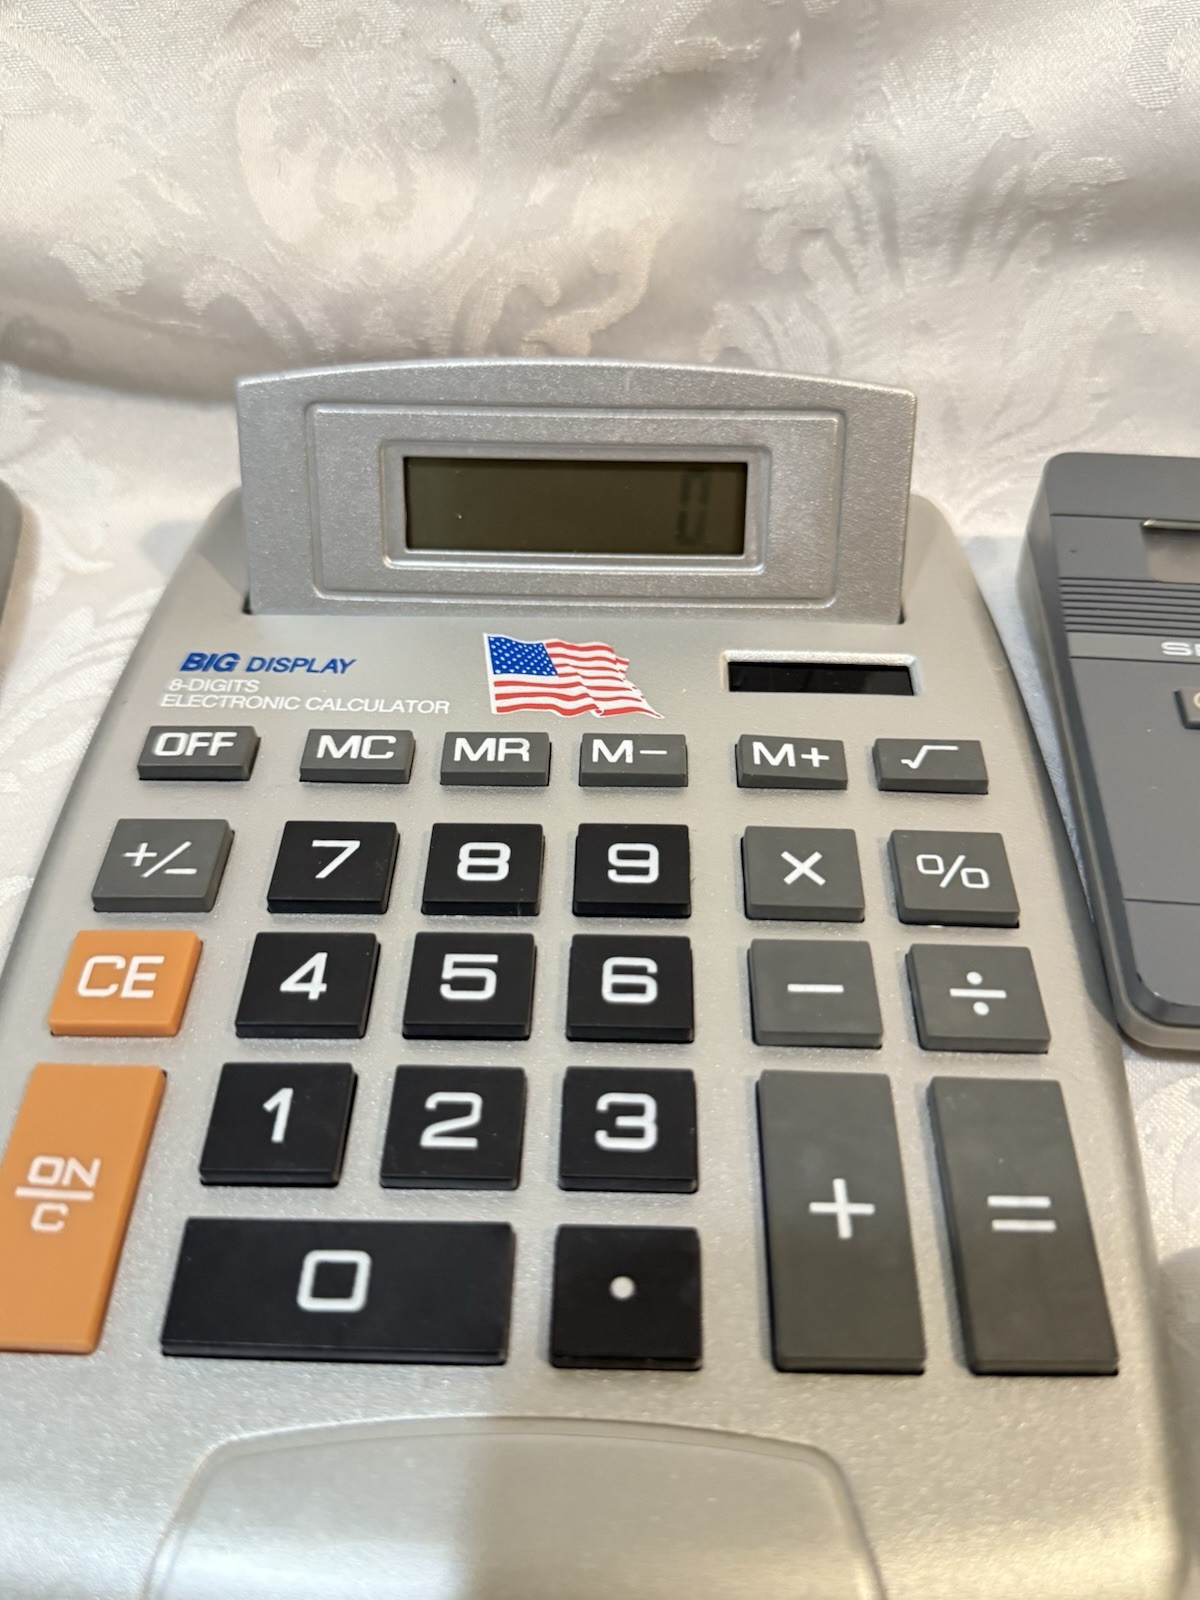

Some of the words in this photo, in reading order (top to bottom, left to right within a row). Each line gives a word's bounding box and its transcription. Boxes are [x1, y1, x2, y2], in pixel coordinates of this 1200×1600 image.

[179, 652, 241, 673] BIG
[246, 656, 357, 675] DISPLAY
[160, 694, 301, 711] ELECTRONIC
[305, 697, 451, 715] CALCULATOR
[168, 678, 260, 693] 8-DIGITS
[153, 731, 238, 757] OFF
[316, 734, 397, 760] MC
[453, 737, 530, 762] MR
[752, 741, 830, 768] M+
[311, 839, 361, 879] 7
[456, 842, 511, 882] 8
[607, 843, 659, 884] 9
[916, 853, 990, 889] %
[76, 955, 165, 999] CE
[279, 952, 329, 1000] 4
[440, 953, 499, 1001] 5
[601, 956, 658, 1004] 6
[262, 1087, 294, 1143] 1
[420, 1091, 483, 1148] 2
[595, 1092, 657, 1151] 3
[27, 1156, 101, 1187] ON
[30, 1203, 69, 1233] C
[808, 1178, 876, 1240] +
[986, 1195, 1056, 1233] =
